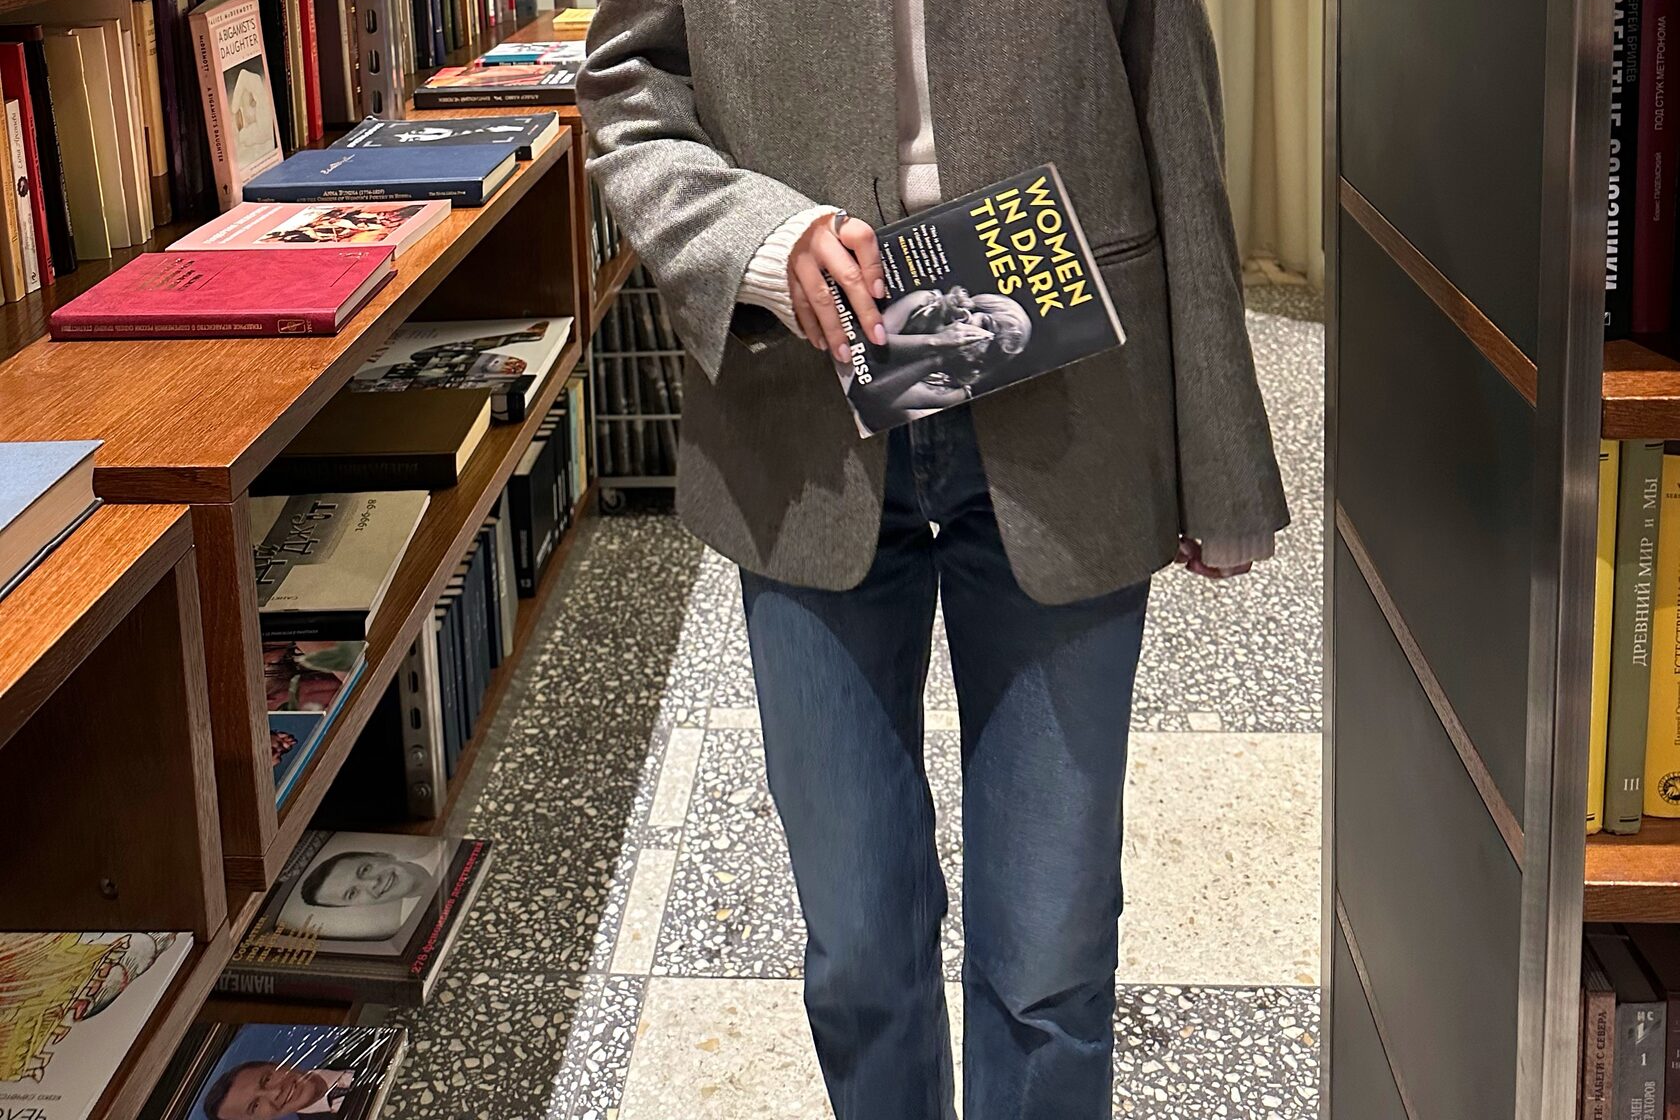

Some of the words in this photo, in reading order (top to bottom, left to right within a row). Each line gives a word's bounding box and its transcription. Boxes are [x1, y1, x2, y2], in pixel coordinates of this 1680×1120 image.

[219, 31, 223, 43] A
[223, 18, 257, 39] BIGAMIST'S
[224, 4, 254, 19] McDERMOTT
[220, 34, 259, 59] DAUGHTER
[1626, 33, 1636, 82] БРИЛЁВ
[1657, 15, 1667, 73] МЕТРОНОМА
[200, 35, 210, 73] McDERMOTT
[208, 94, 217, 130] BIGAMIST'S
[214, 130, 223, 162] DAUGHTER
[1656, 75, 1665, 105] СТУК
[1654, 105, 1664, 130] ПОД
[996, 187, 1028, 224] IN
[898, 235, 909, 255] HELENA
[969, 198, 1023, 297] TIMES
[1025, 176, 1094, 308] WOMEN
[1010, 229, 1065, 317] DARK
[849, 342, 873, 386] Rose
[1643, 477, 1658, 510] МЫ
[355, 499, 377, 532] 1996-98
[1645, 517, 1655, 528] и
[1637, 537, 1654, 582] МИР
[1632, 582, 1651, 666] ДРЕВНИЙ
[411, 953, 428, 974] 278
[426, 898, 456, 955] феноменов
[451, 841, 484, 901] десятилетия
[1597, 1011, 1607, 1050] СЕВЕРА
[1596, 1051, 1605, 1059] С
